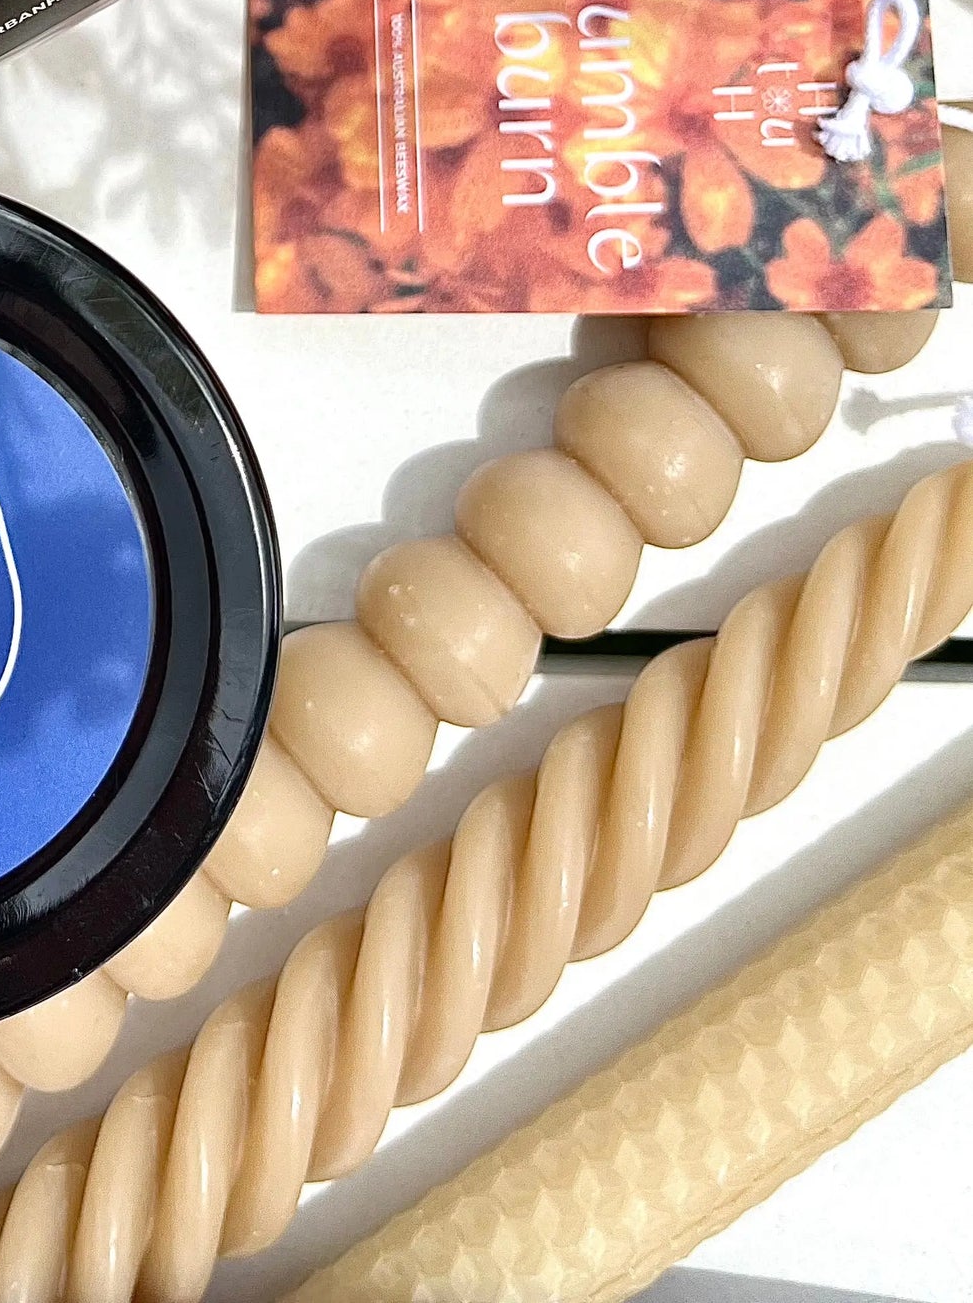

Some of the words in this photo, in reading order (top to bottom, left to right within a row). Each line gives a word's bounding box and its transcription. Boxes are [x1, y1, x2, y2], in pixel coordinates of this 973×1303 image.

[392, 52, 407, 141] AUSTRALIAN
[494, 12, 570, 207] burn
[394, 142, 411, 214] BEESWAX
